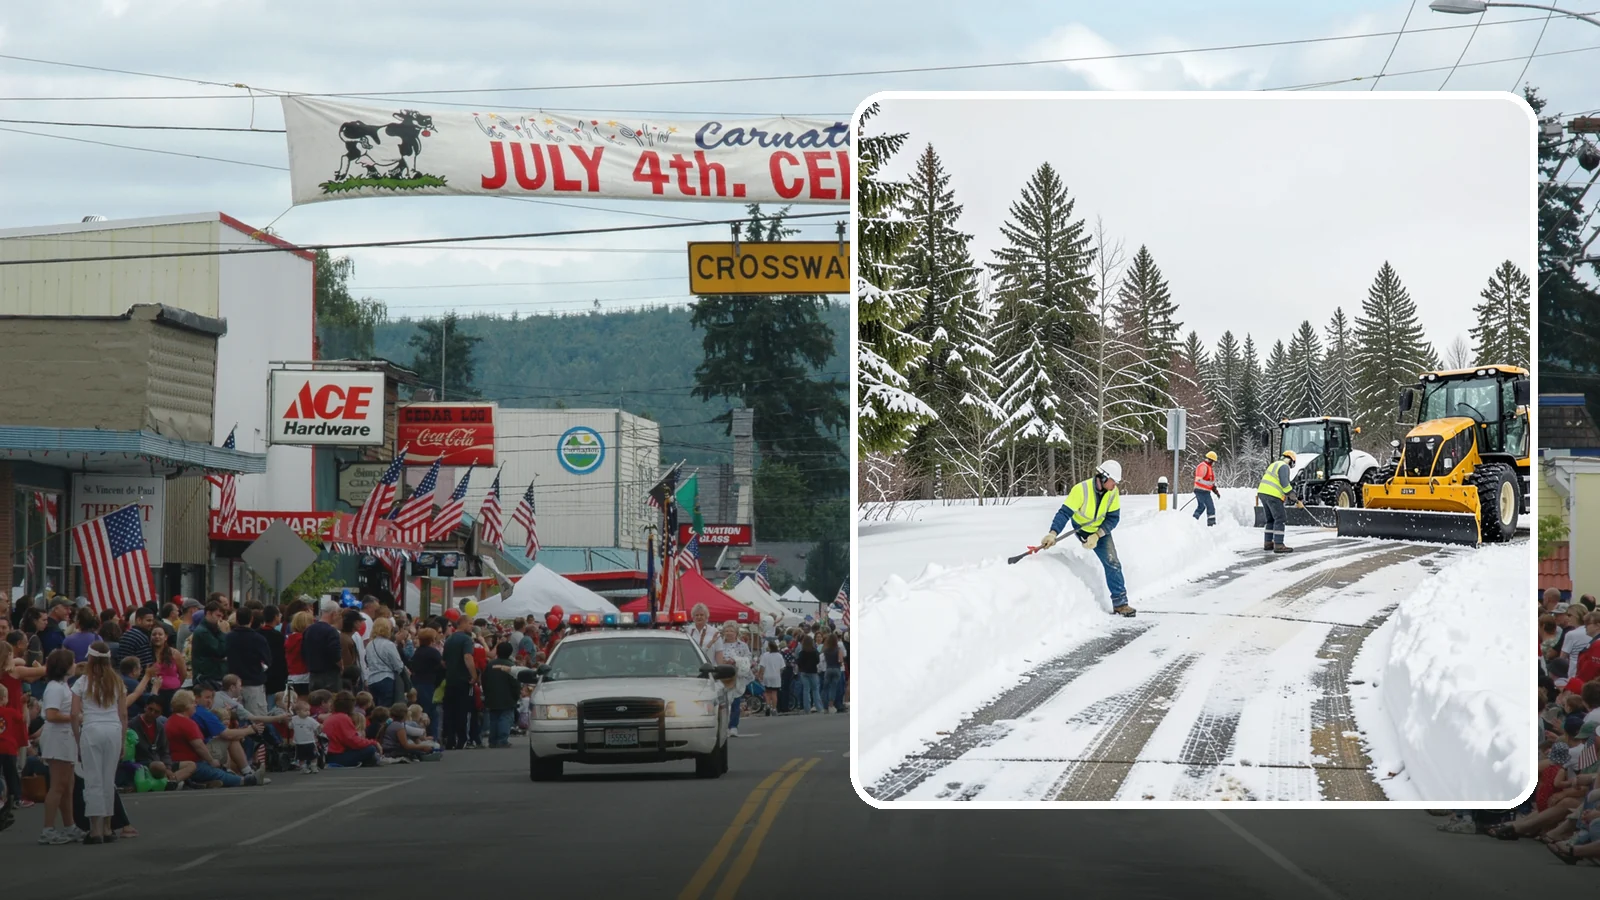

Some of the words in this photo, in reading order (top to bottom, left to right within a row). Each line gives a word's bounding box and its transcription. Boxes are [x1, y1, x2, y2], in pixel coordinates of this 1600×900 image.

[481, 141, 604, 192] JULY
[632, 150, 746, 197] 4th.
[697, 254, 850, 280] CROSSWA
[283, 380, 373, 419] ACE
[406, 409, 452, 421] CEDAR
[283, 421, 370, 436] Hardware
[416, 428, 476, 446] Coca-Cola
[353, 467, 383, 480] Simpl
[96, 485, 124, 494] Vincent
[126, 486, 136, 495] de
[138, 486, 155, 495] Paul
[81, 503, 154, 522] THT
[212, 516, 331, 536] HARDARE
[688, 526, 741, 535] CRNATION
[699, 535, 730, 544] GLASS
